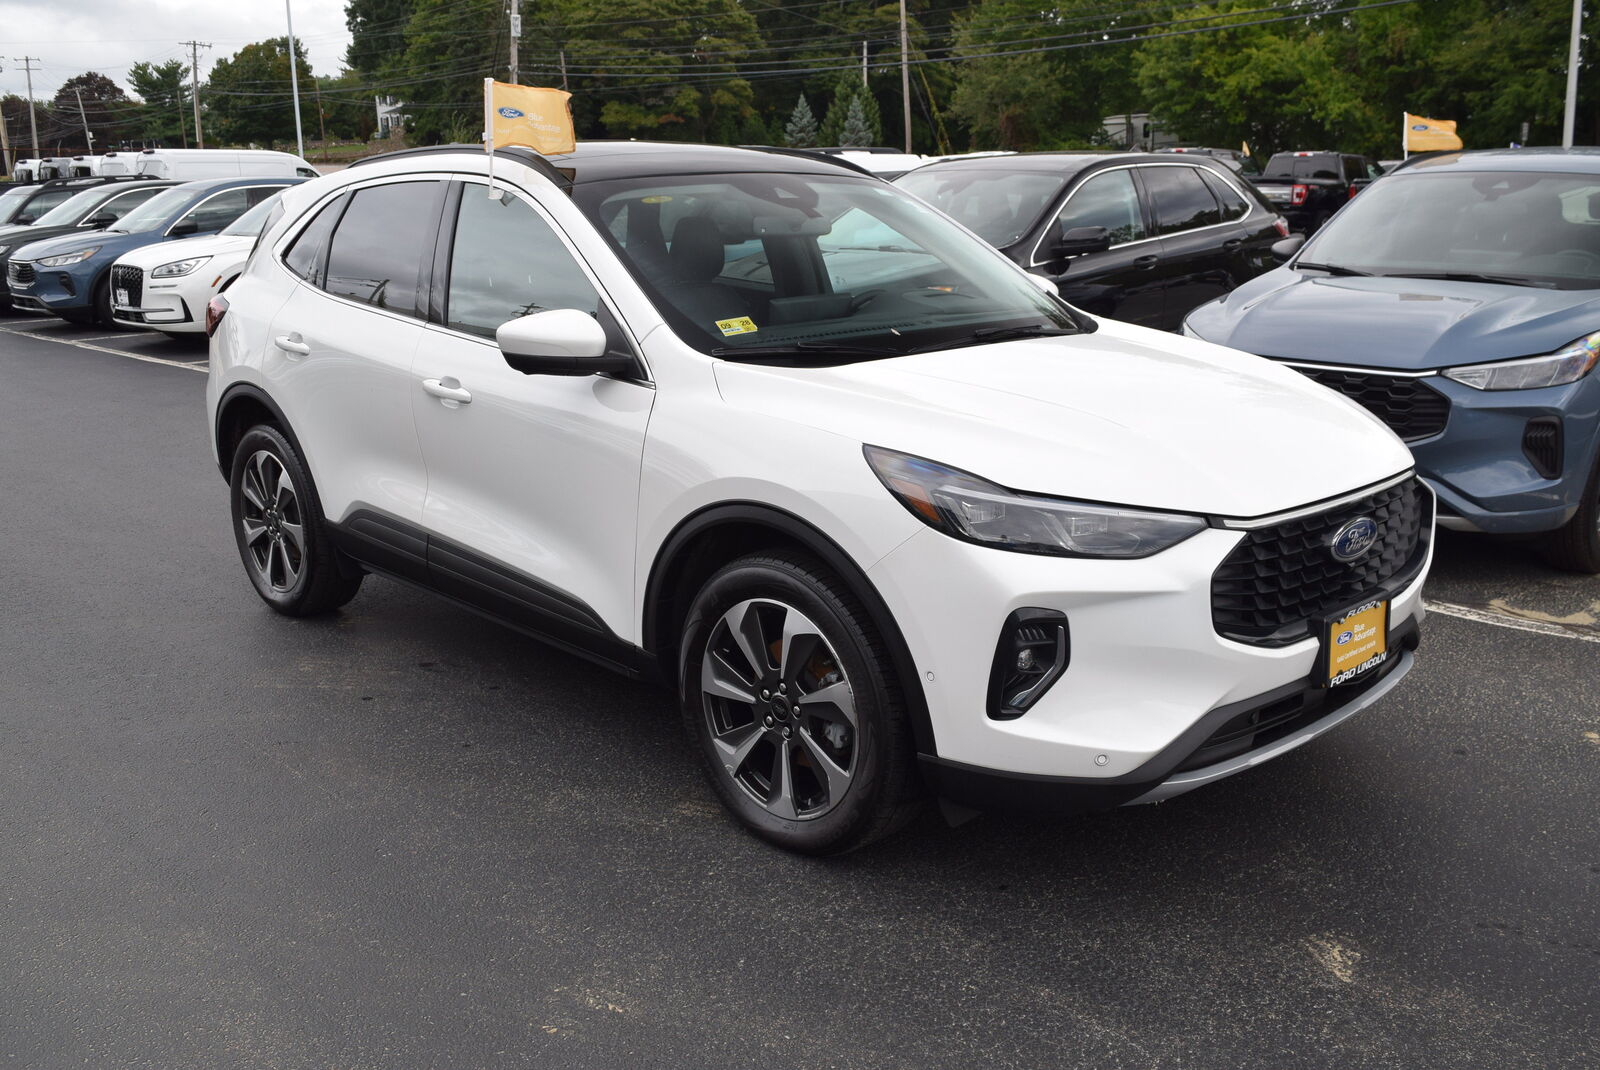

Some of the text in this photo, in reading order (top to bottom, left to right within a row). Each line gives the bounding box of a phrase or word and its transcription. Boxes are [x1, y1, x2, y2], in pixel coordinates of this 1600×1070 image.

[501, 108, 520, 118] Ford
[528, 113, 543, 121] Blue
[1345, 526, 1371, 553] Ford
[1346, 601, 1376, 618] FLOOD
[1353, 623, 1365, 633] Blue
[1330, 652, 1386, 687] FORD LINCOLN
